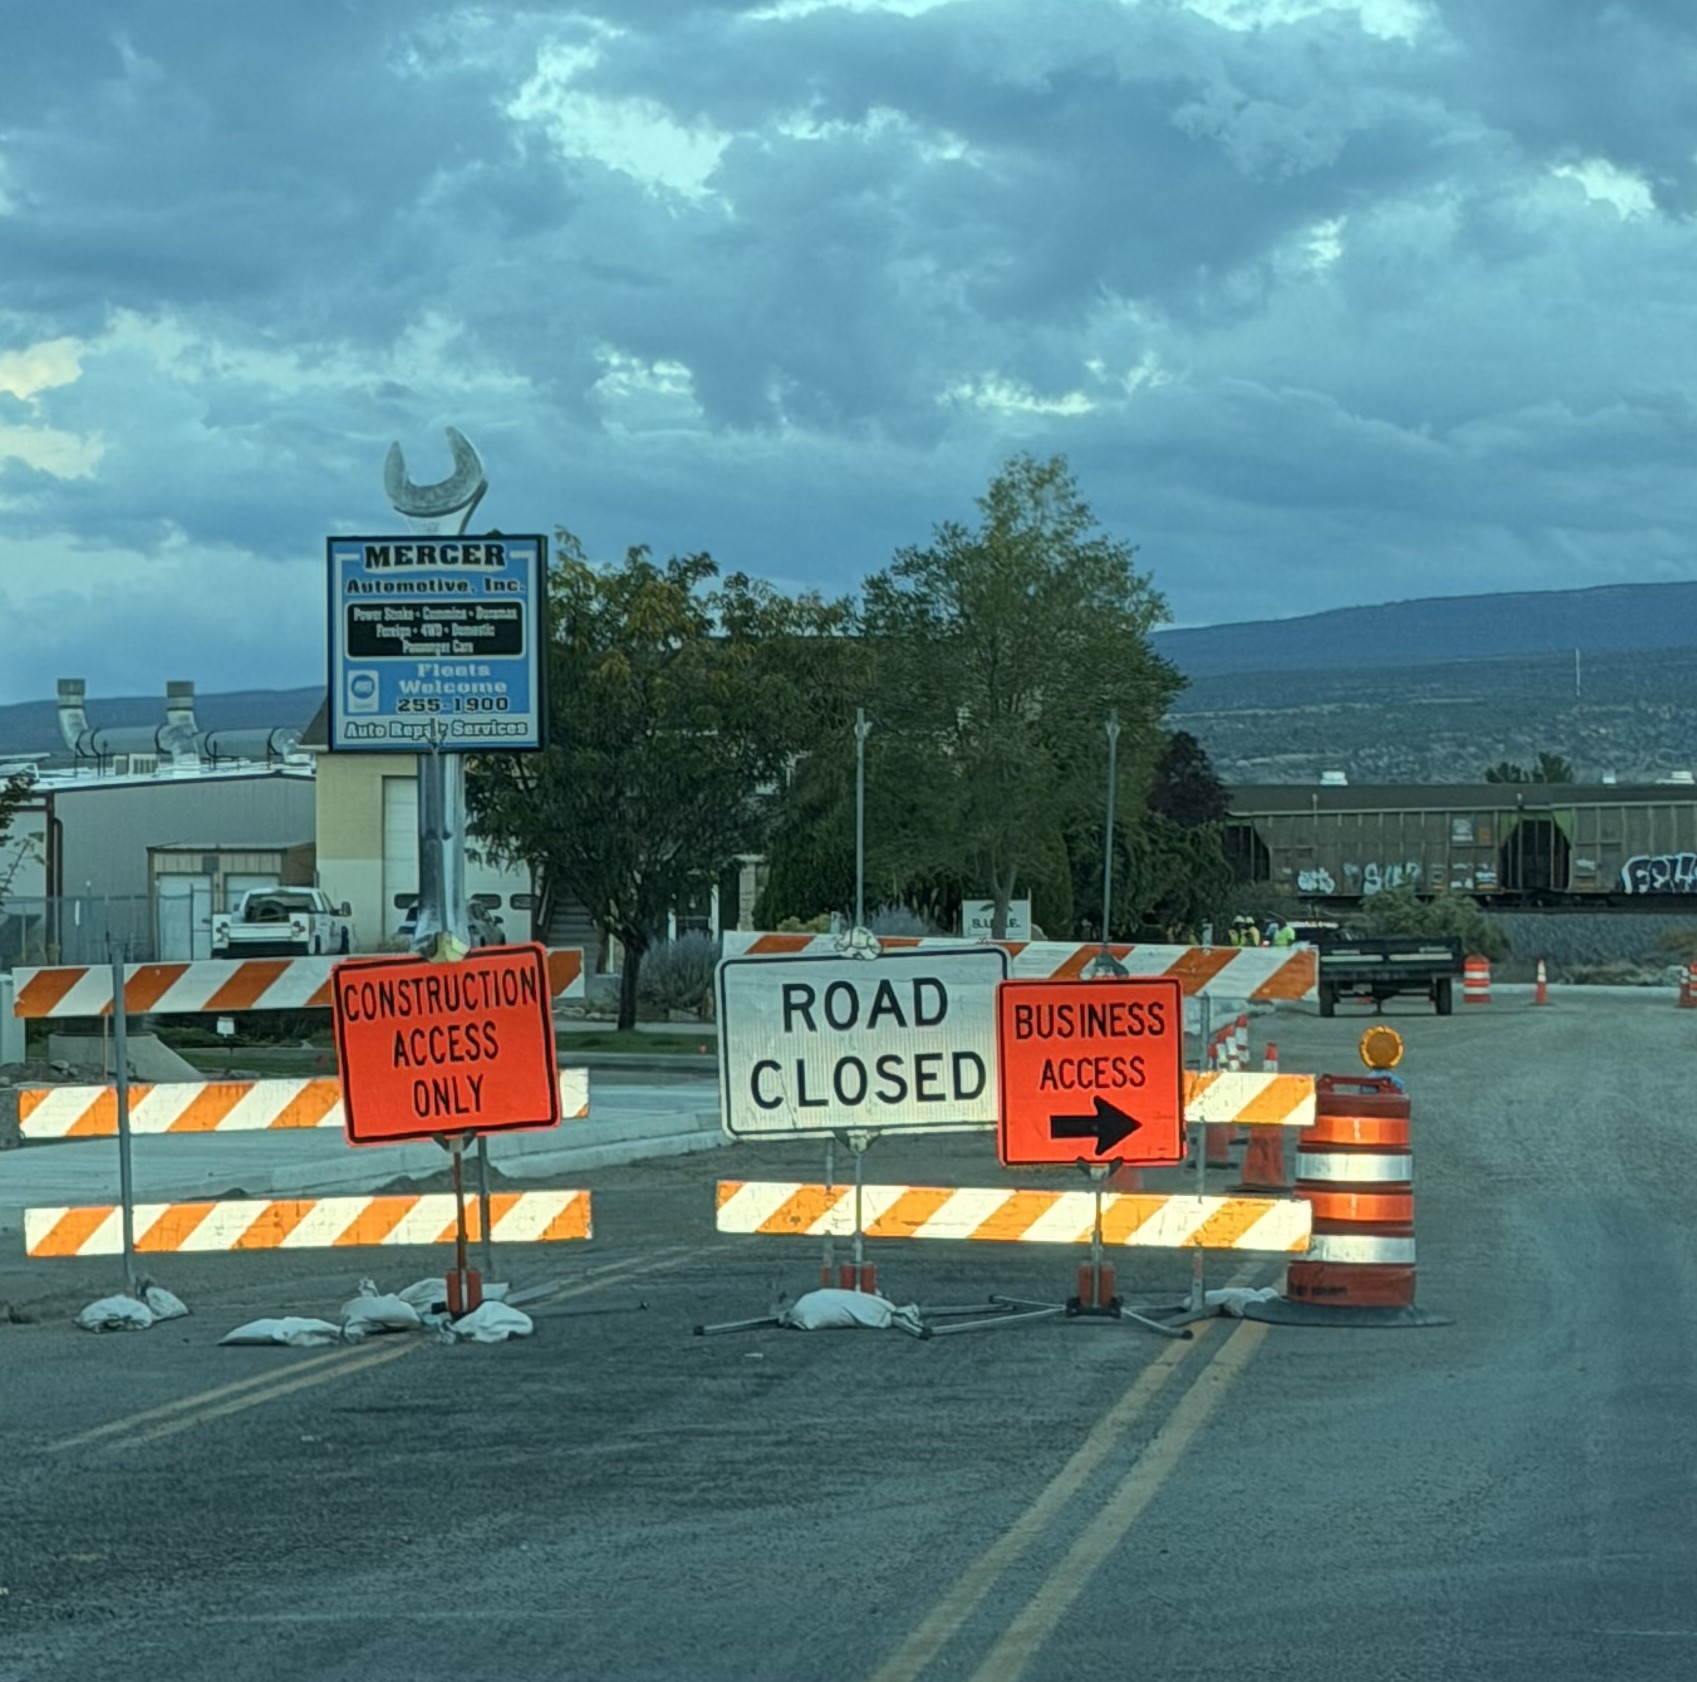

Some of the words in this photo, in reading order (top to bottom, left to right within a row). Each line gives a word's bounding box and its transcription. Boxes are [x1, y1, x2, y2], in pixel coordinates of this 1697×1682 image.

[365, 544, 506, 569] MERCER
[484, 577, 525, 592] Inc.
[353, 607, 382, 621] Power
[399, 680, 508, 694] Welcome
[417, 663, 490, 677] Fleets
[345, 721, 386, 739] Auto
[389, 720, 448, 740] Repar
[451, 719, 529, 737] Services
[344, 966, 537, 1022] CONSTRUCTION
[782, 977, 948, 1033] ROAD
[1015, 1002, 1166, 1041] BUSINESS
[393, 1020, 499, 1068] ACCESS
[750, 1050, 987, 1110] CLOSED
[1039, 1056, 1146, 1091] ACCESS
[413, 1073, 484, 1118] ONLY
